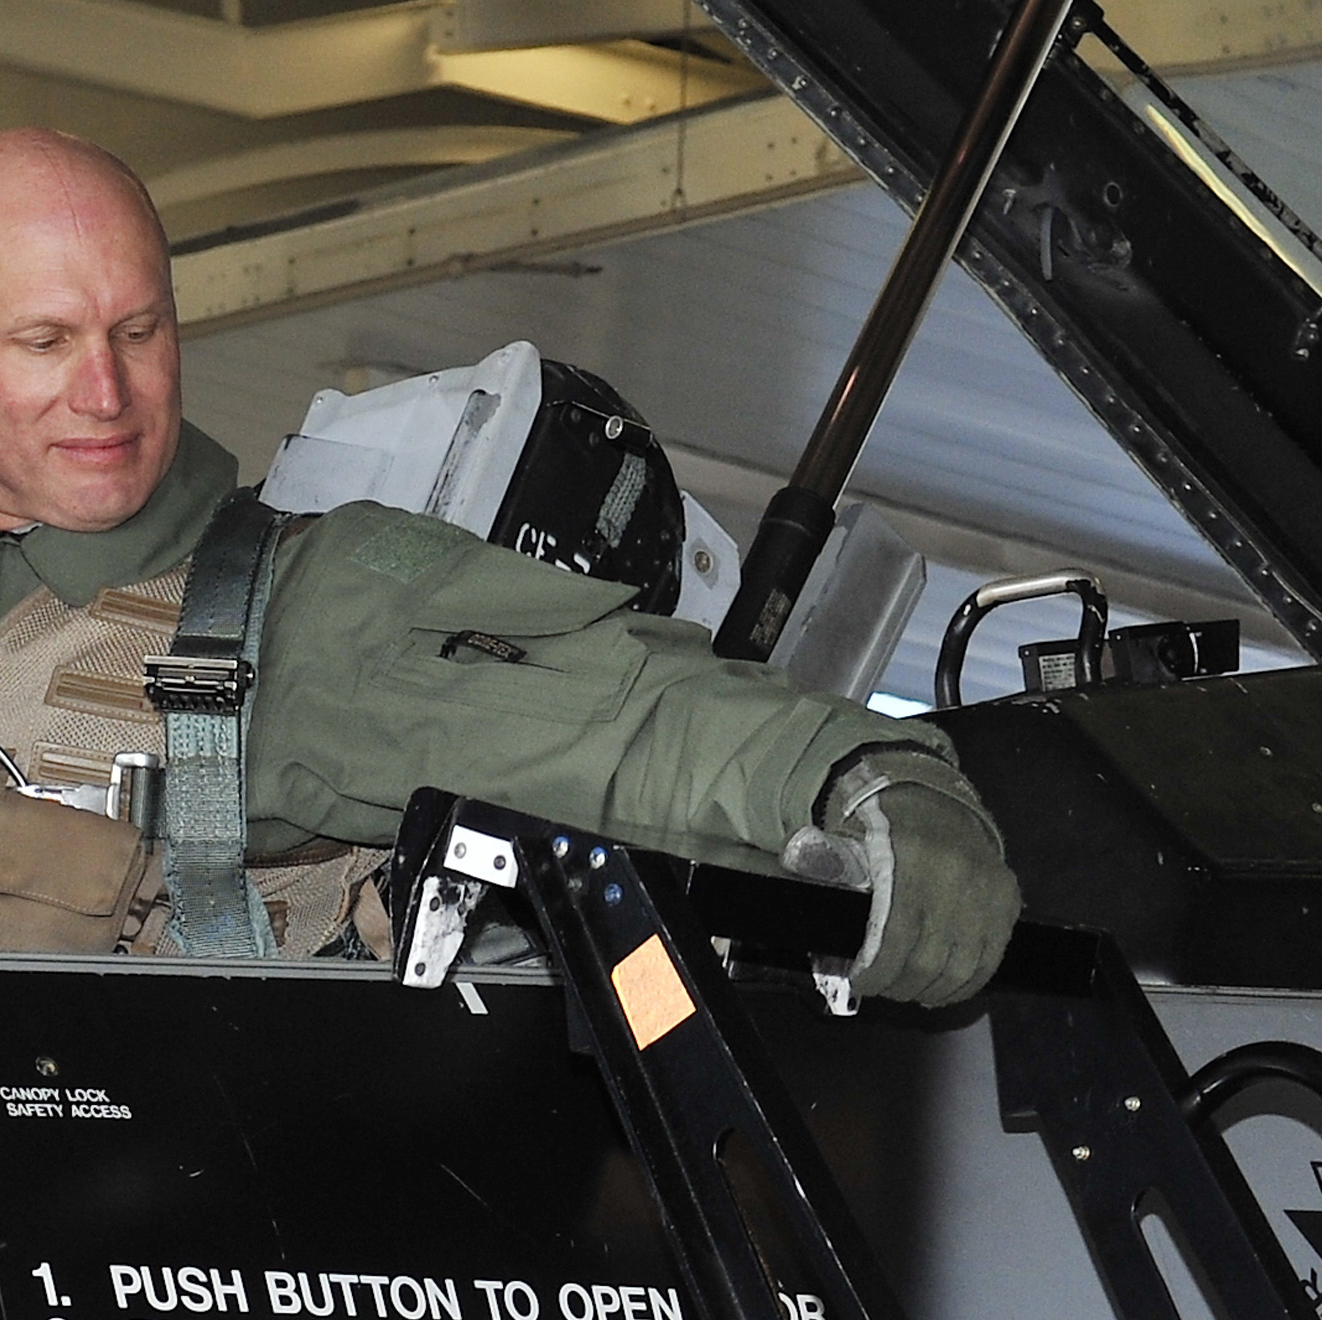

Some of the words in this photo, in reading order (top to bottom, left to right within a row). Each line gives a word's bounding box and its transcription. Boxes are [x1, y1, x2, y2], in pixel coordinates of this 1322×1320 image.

[0, 1086, 60, 1101] CANOPY
[64, 1088, 111, 1102] LOCK
[6, 1102, 64, 1118] SAFETY
[71, 1104, 133, 1119] ACCESS
[31, 1262, 72, 1307] 1.
[109, 1264, 250, 1313] PUSH
[264, 1270, 463, 1320] BUTTON
